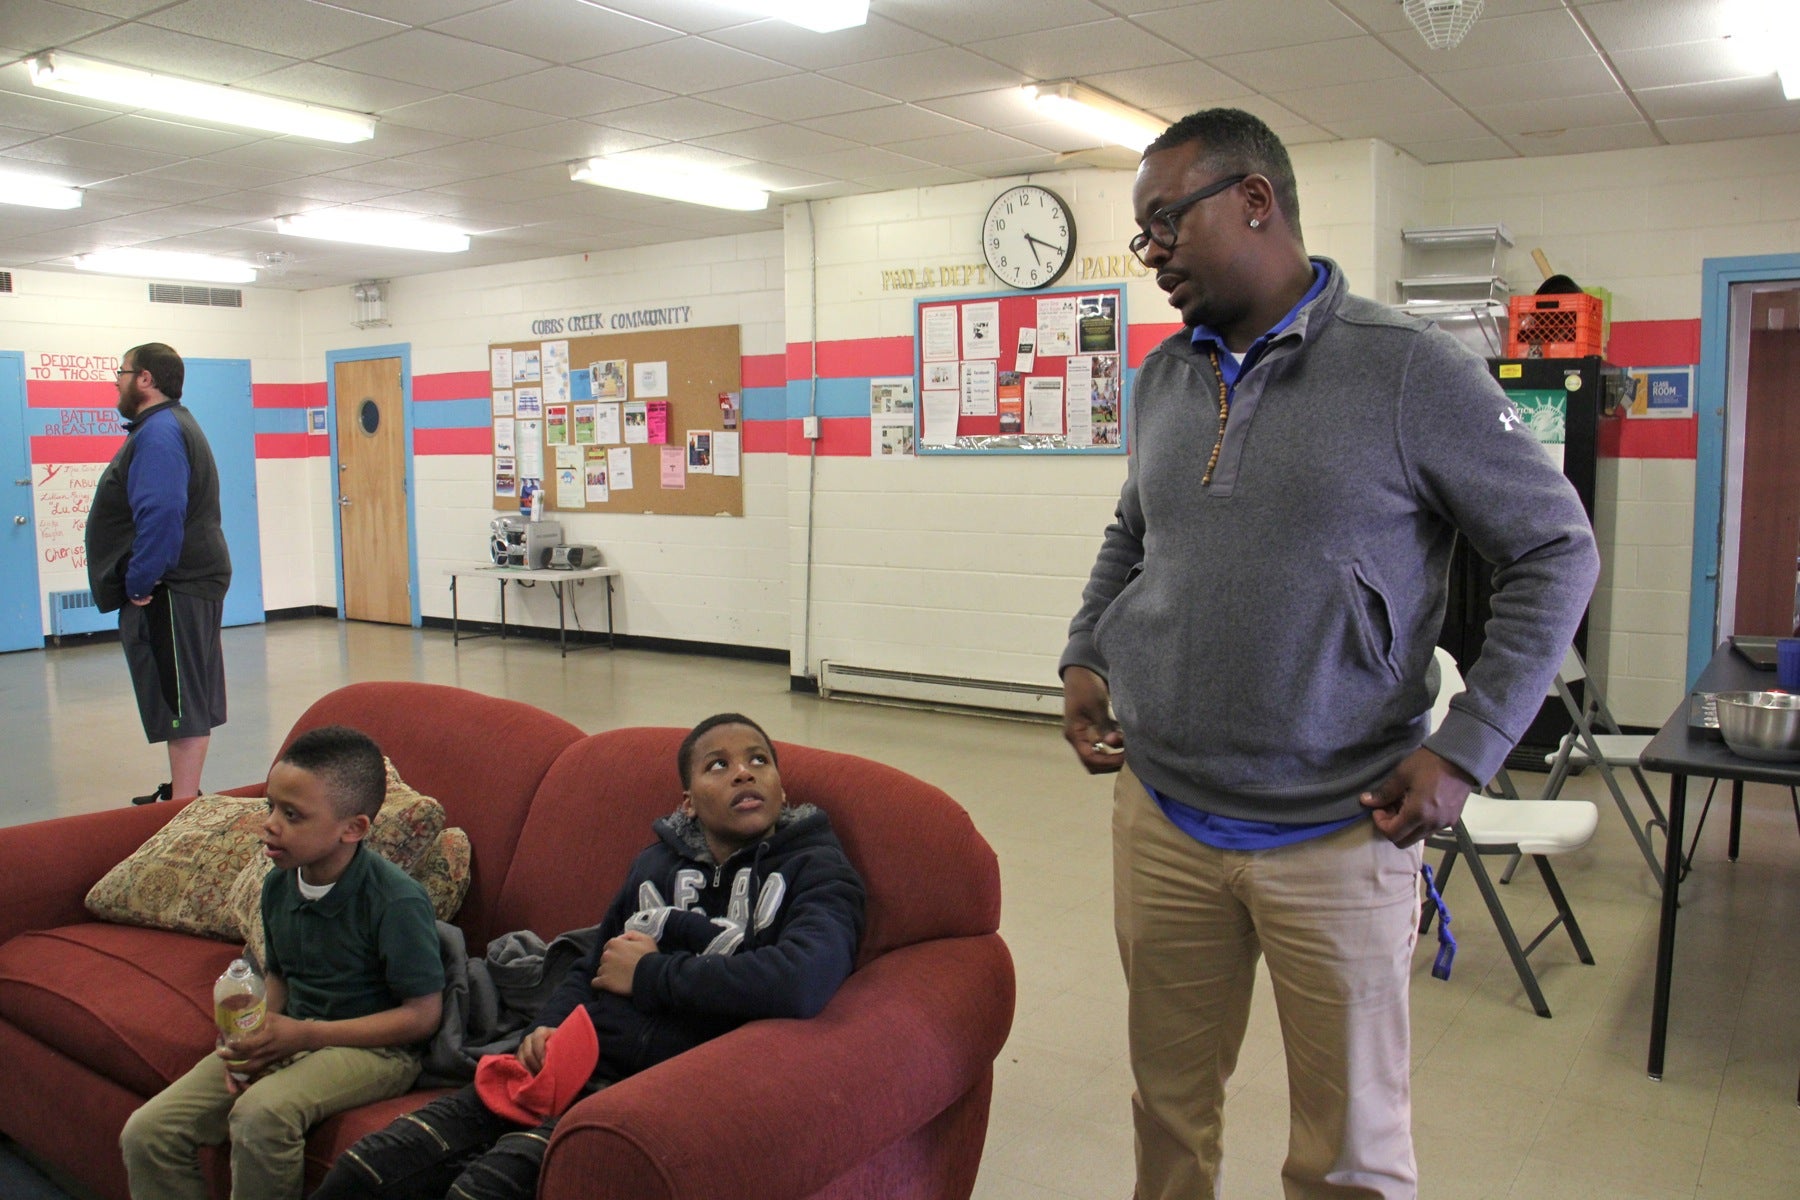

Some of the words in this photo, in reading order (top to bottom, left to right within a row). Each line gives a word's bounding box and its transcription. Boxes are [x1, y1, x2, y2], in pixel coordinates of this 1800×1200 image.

[1019, 194, 1029, 206] 12
[1040, 196, 1043, 208] 1
[1006, 202, 1013, 215] 11
[1052, 207, 1059, 219] 2
[996, 219, 1005, 231] 10
[1059, 226, 1067, 237] 3
[993, 238, 1000, 249] 9
[1000, 256, 1007, 267] 8
[1046, 262, 1053, 273] 5
[881, 267, 935, 290] PHILA
[940, 263, 987, 287] DEPT
[1014, 267, 1020, 278] 7
[1030, 269, 1037, 280] 6
[531, 318, 564, 335] COBBS
[567, 313, 604, 332] CREEK
[610, 305, 690, 329] COMMUNITY
[40, 353, 119, 371] DEDICATED
[31, 367, 51, 379] TO
[59, 368, 108, 380] THOSE
[1652, 386, 1677, 396] ROOM
[60, 409, 119, 424] BATTLED
[45, 423, 96, 436] BREAST
